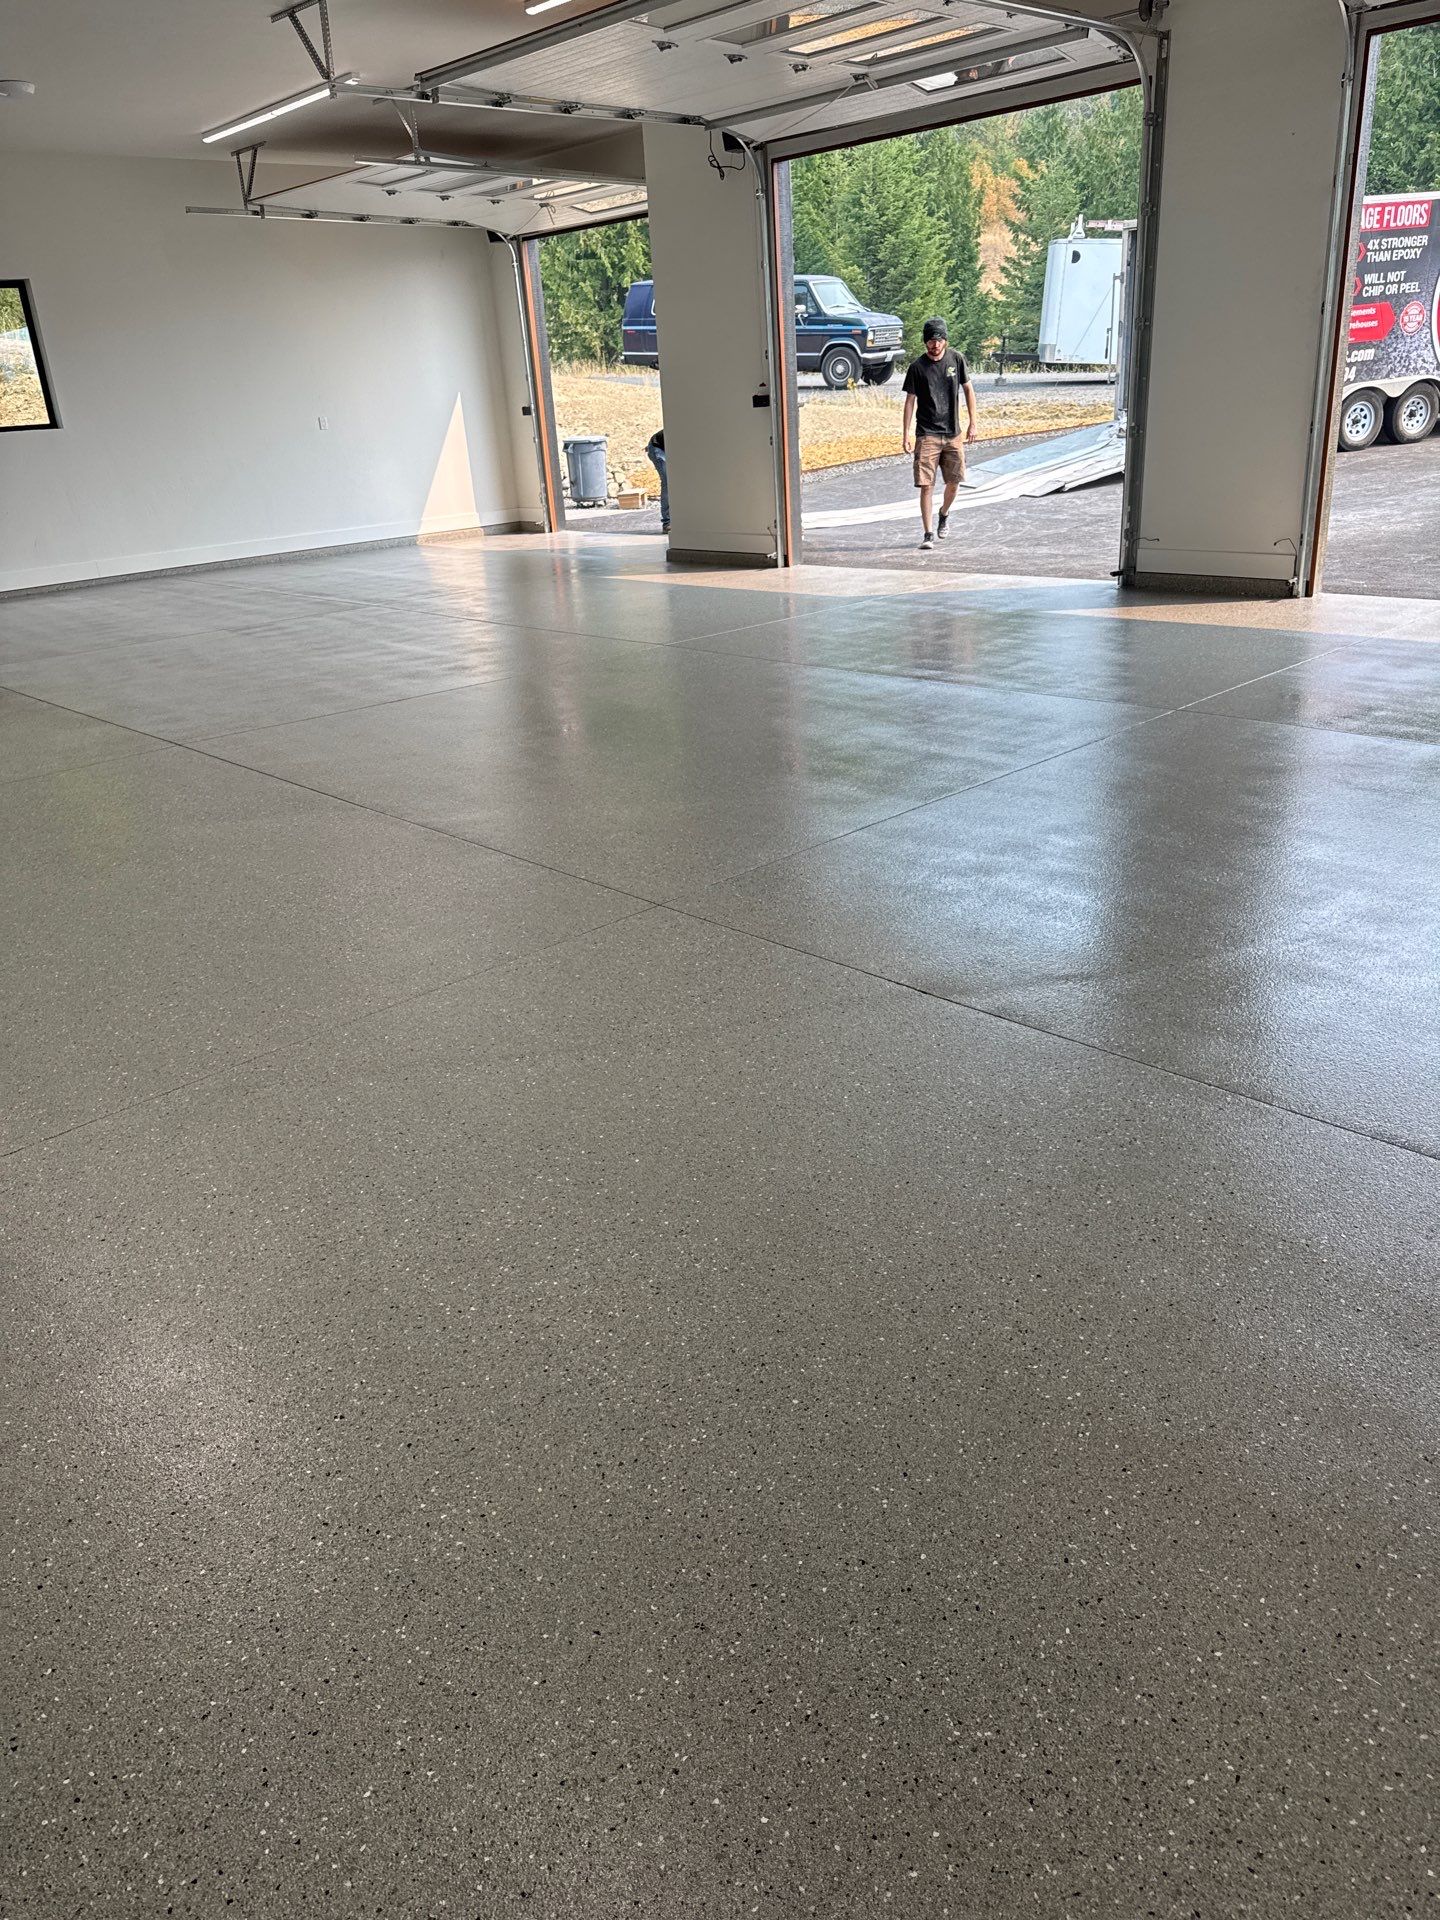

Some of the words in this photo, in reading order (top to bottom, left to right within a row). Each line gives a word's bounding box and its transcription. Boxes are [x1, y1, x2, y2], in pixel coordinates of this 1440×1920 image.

[1383, 203, 1428, 228] FLOORS
[1367, 239, 1380, 250] 4X
[1380, 235, 1428, 249] STRONGER
[1366, 250, 1392, 263] THAN
[1392, 248, 1422, 260] EPOXY
[1364, 273, 1386, 284] WILL
[1387, 271, 1406, 283] NOT
[1362, 285, 1384, 297] CHIP
[1386, 284, 1398, 294] OR
[1399, 282, 1420, 294] PEEL
